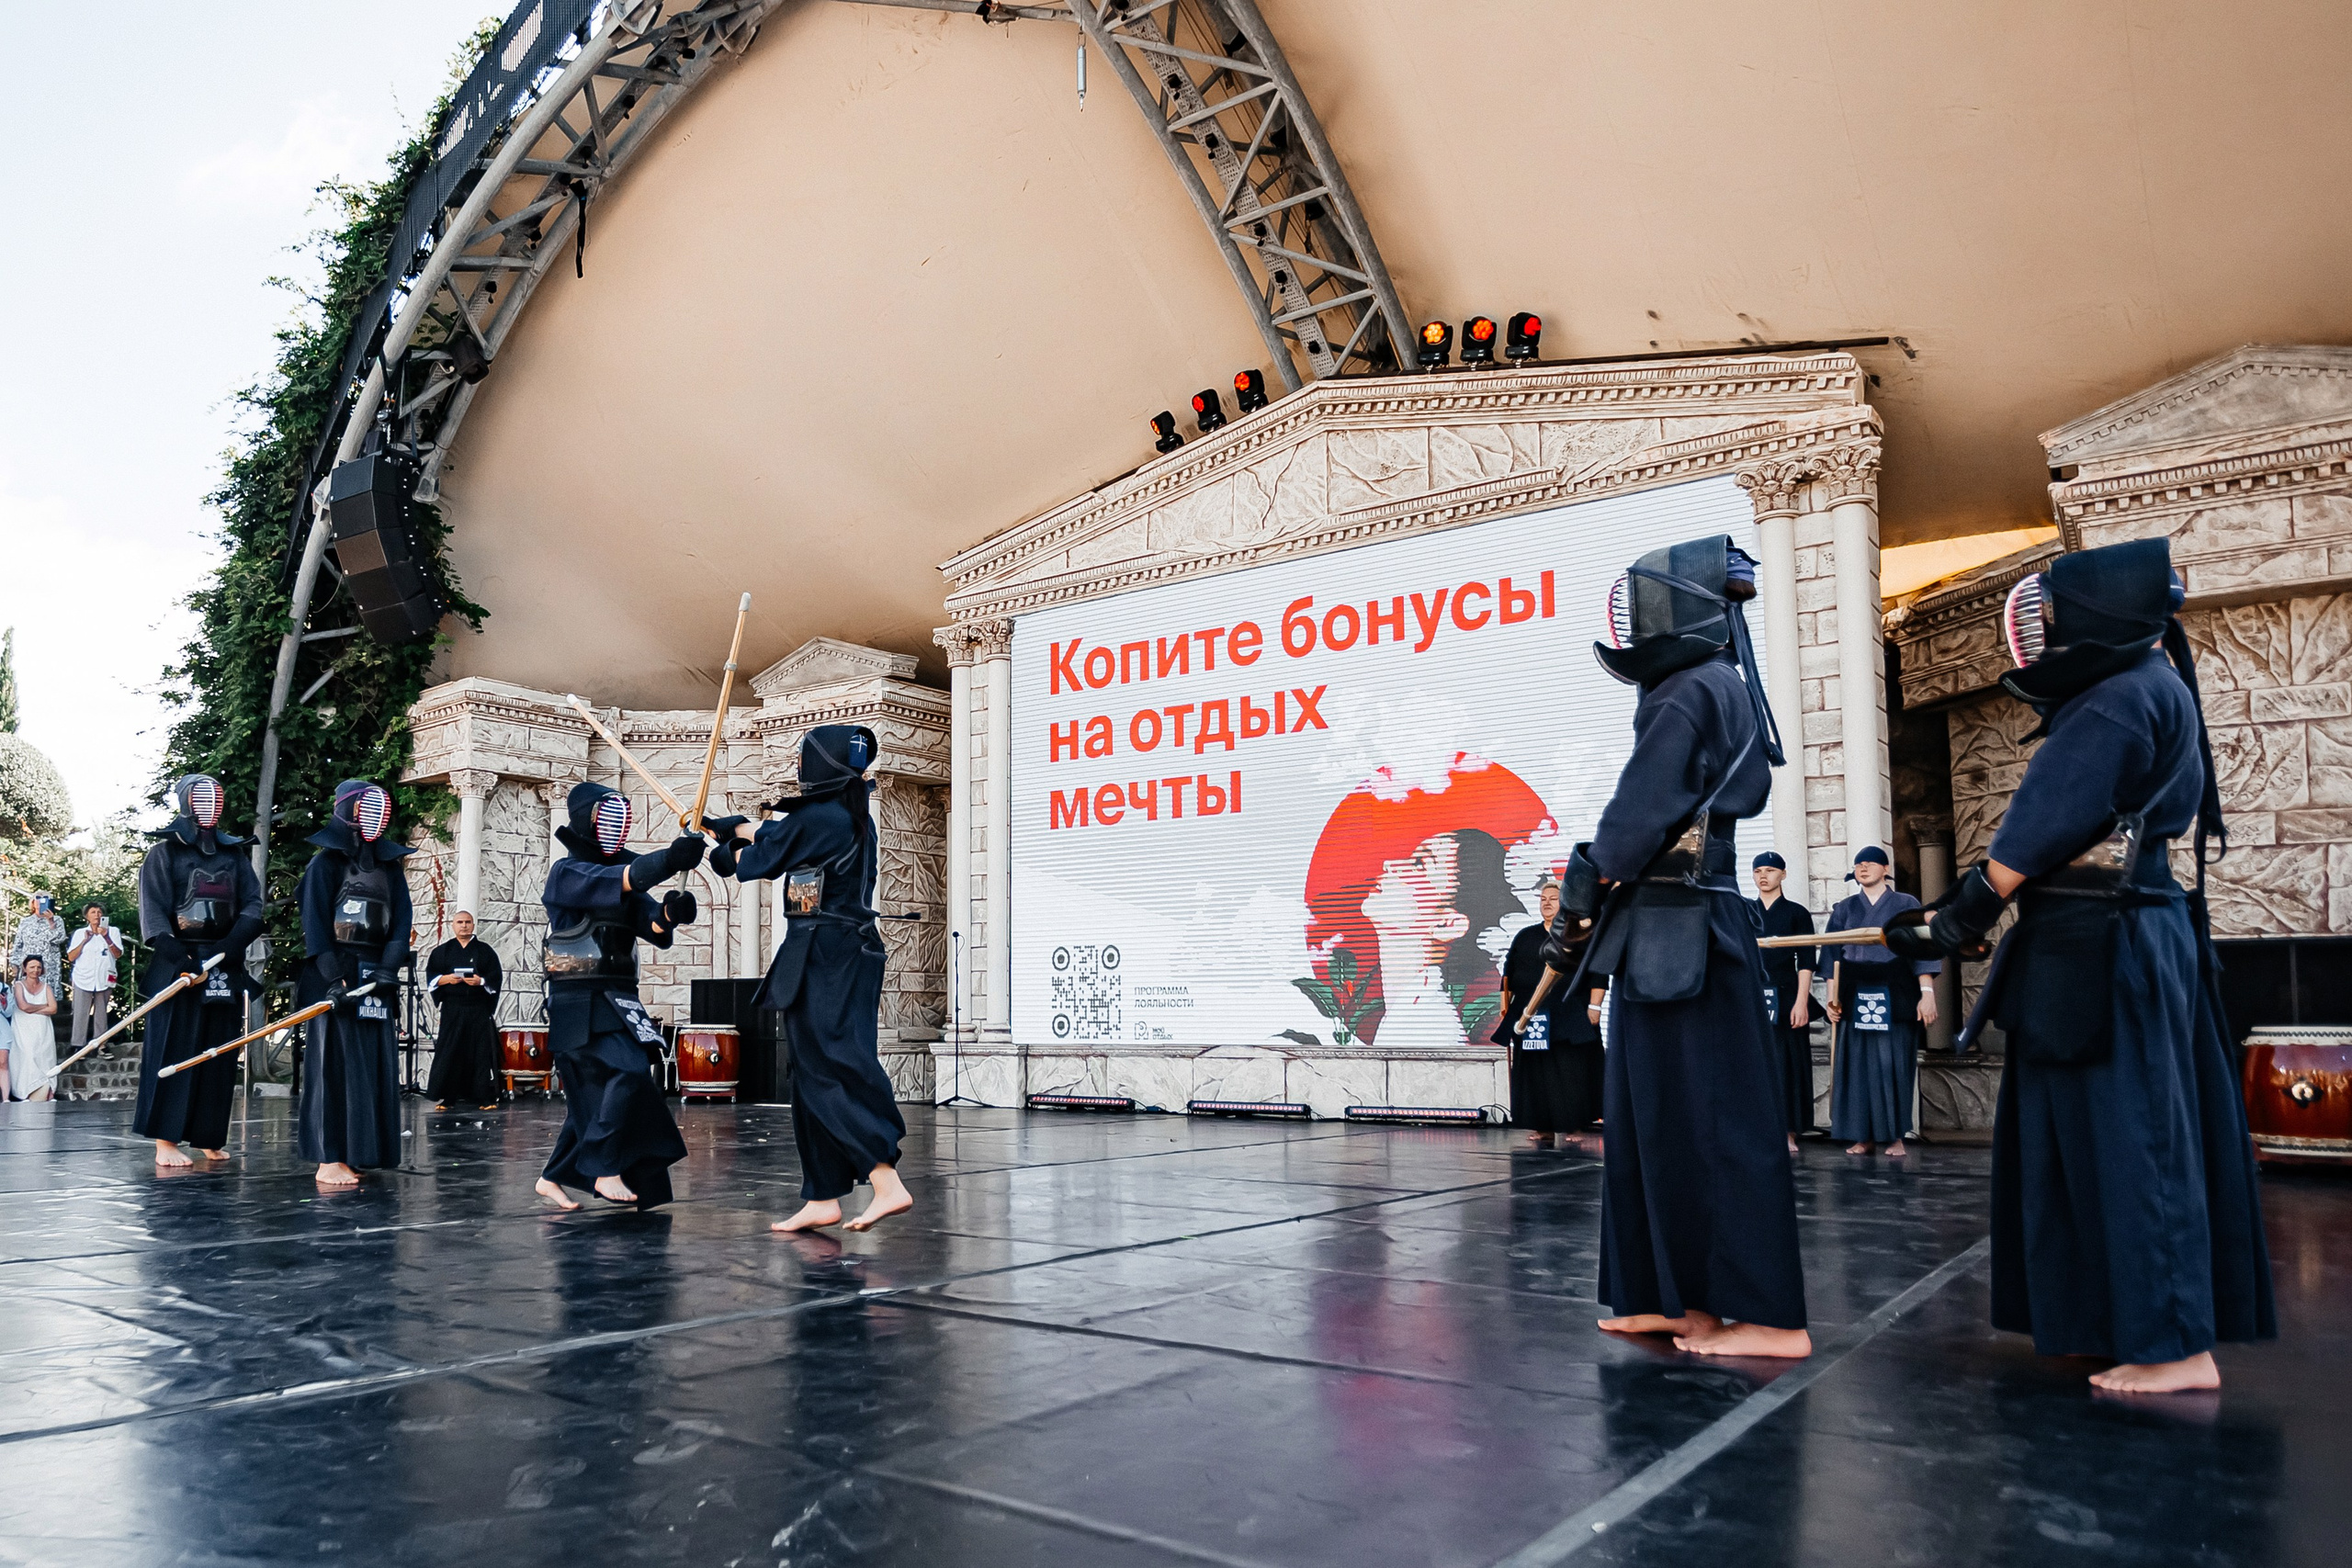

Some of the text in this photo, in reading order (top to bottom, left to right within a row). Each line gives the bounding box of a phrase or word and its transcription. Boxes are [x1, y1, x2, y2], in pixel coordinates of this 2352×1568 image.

[1050, 570, 1555, 695] Копите бонусы
[1049, 684, 1328, 762] на отдых
[1050, 771, 1241, 829] мечты
[1134, 986, 1189, 996] ПРОГРАММА
[1134, 998, 1194, 1009] ЛОЯЛЬНОСТИ
